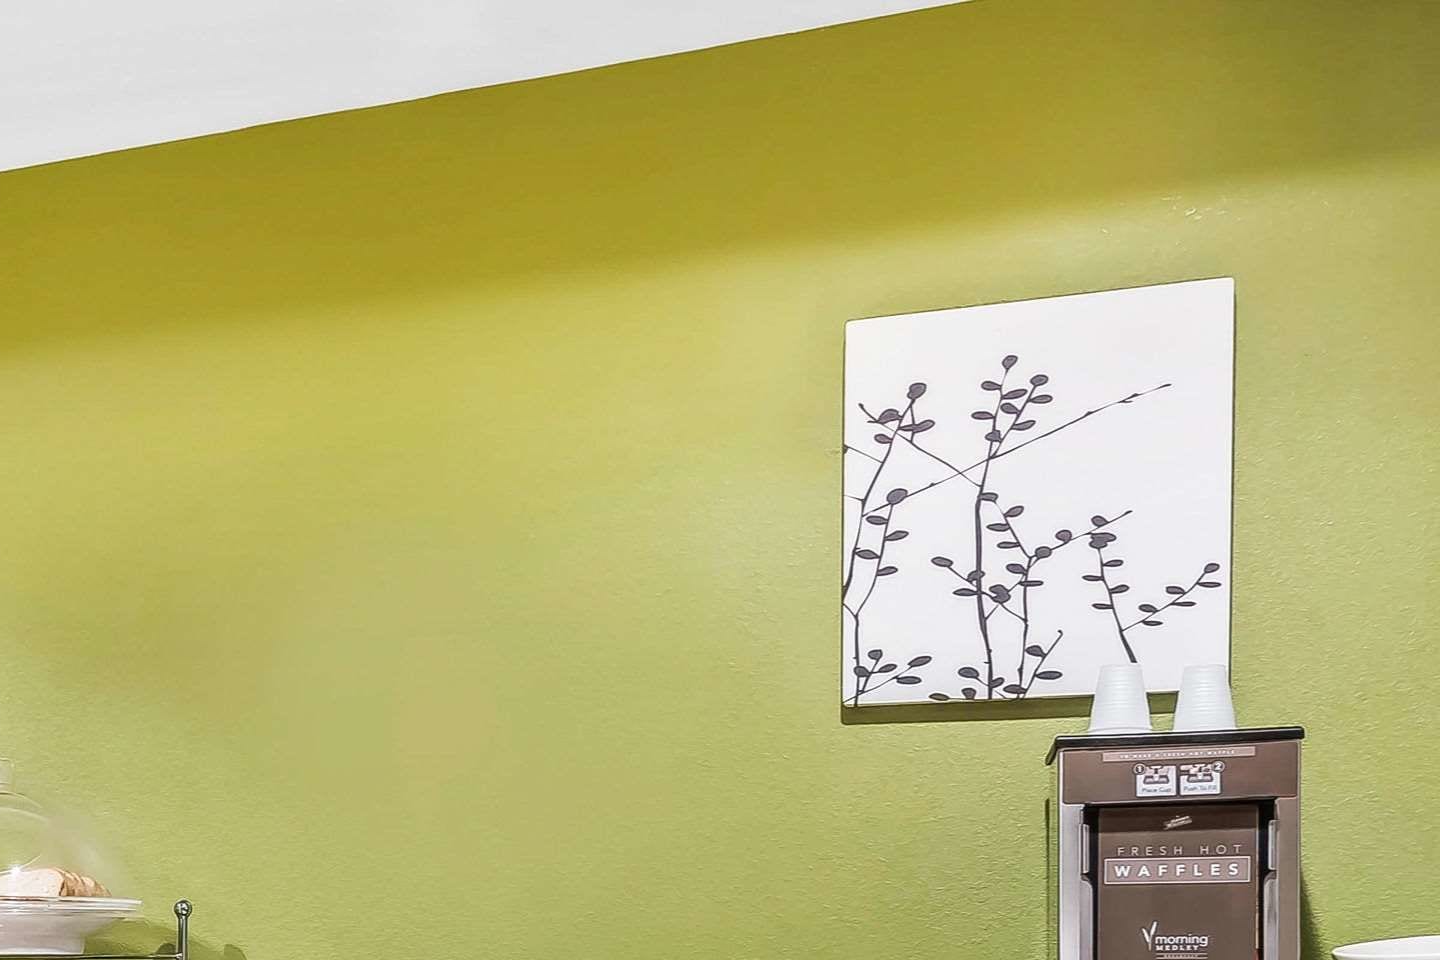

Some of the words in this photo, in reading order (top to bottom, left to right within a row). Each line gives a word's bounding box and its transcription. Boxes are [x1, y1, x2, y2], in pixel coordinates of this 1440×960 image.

[1117, 846, 1183, 856] FRESH
[1200, 844, 1242, 855] HOT
[1114, 863, 1239, 877] WAFFLES
[1155, 934, 1209, 946] morning
